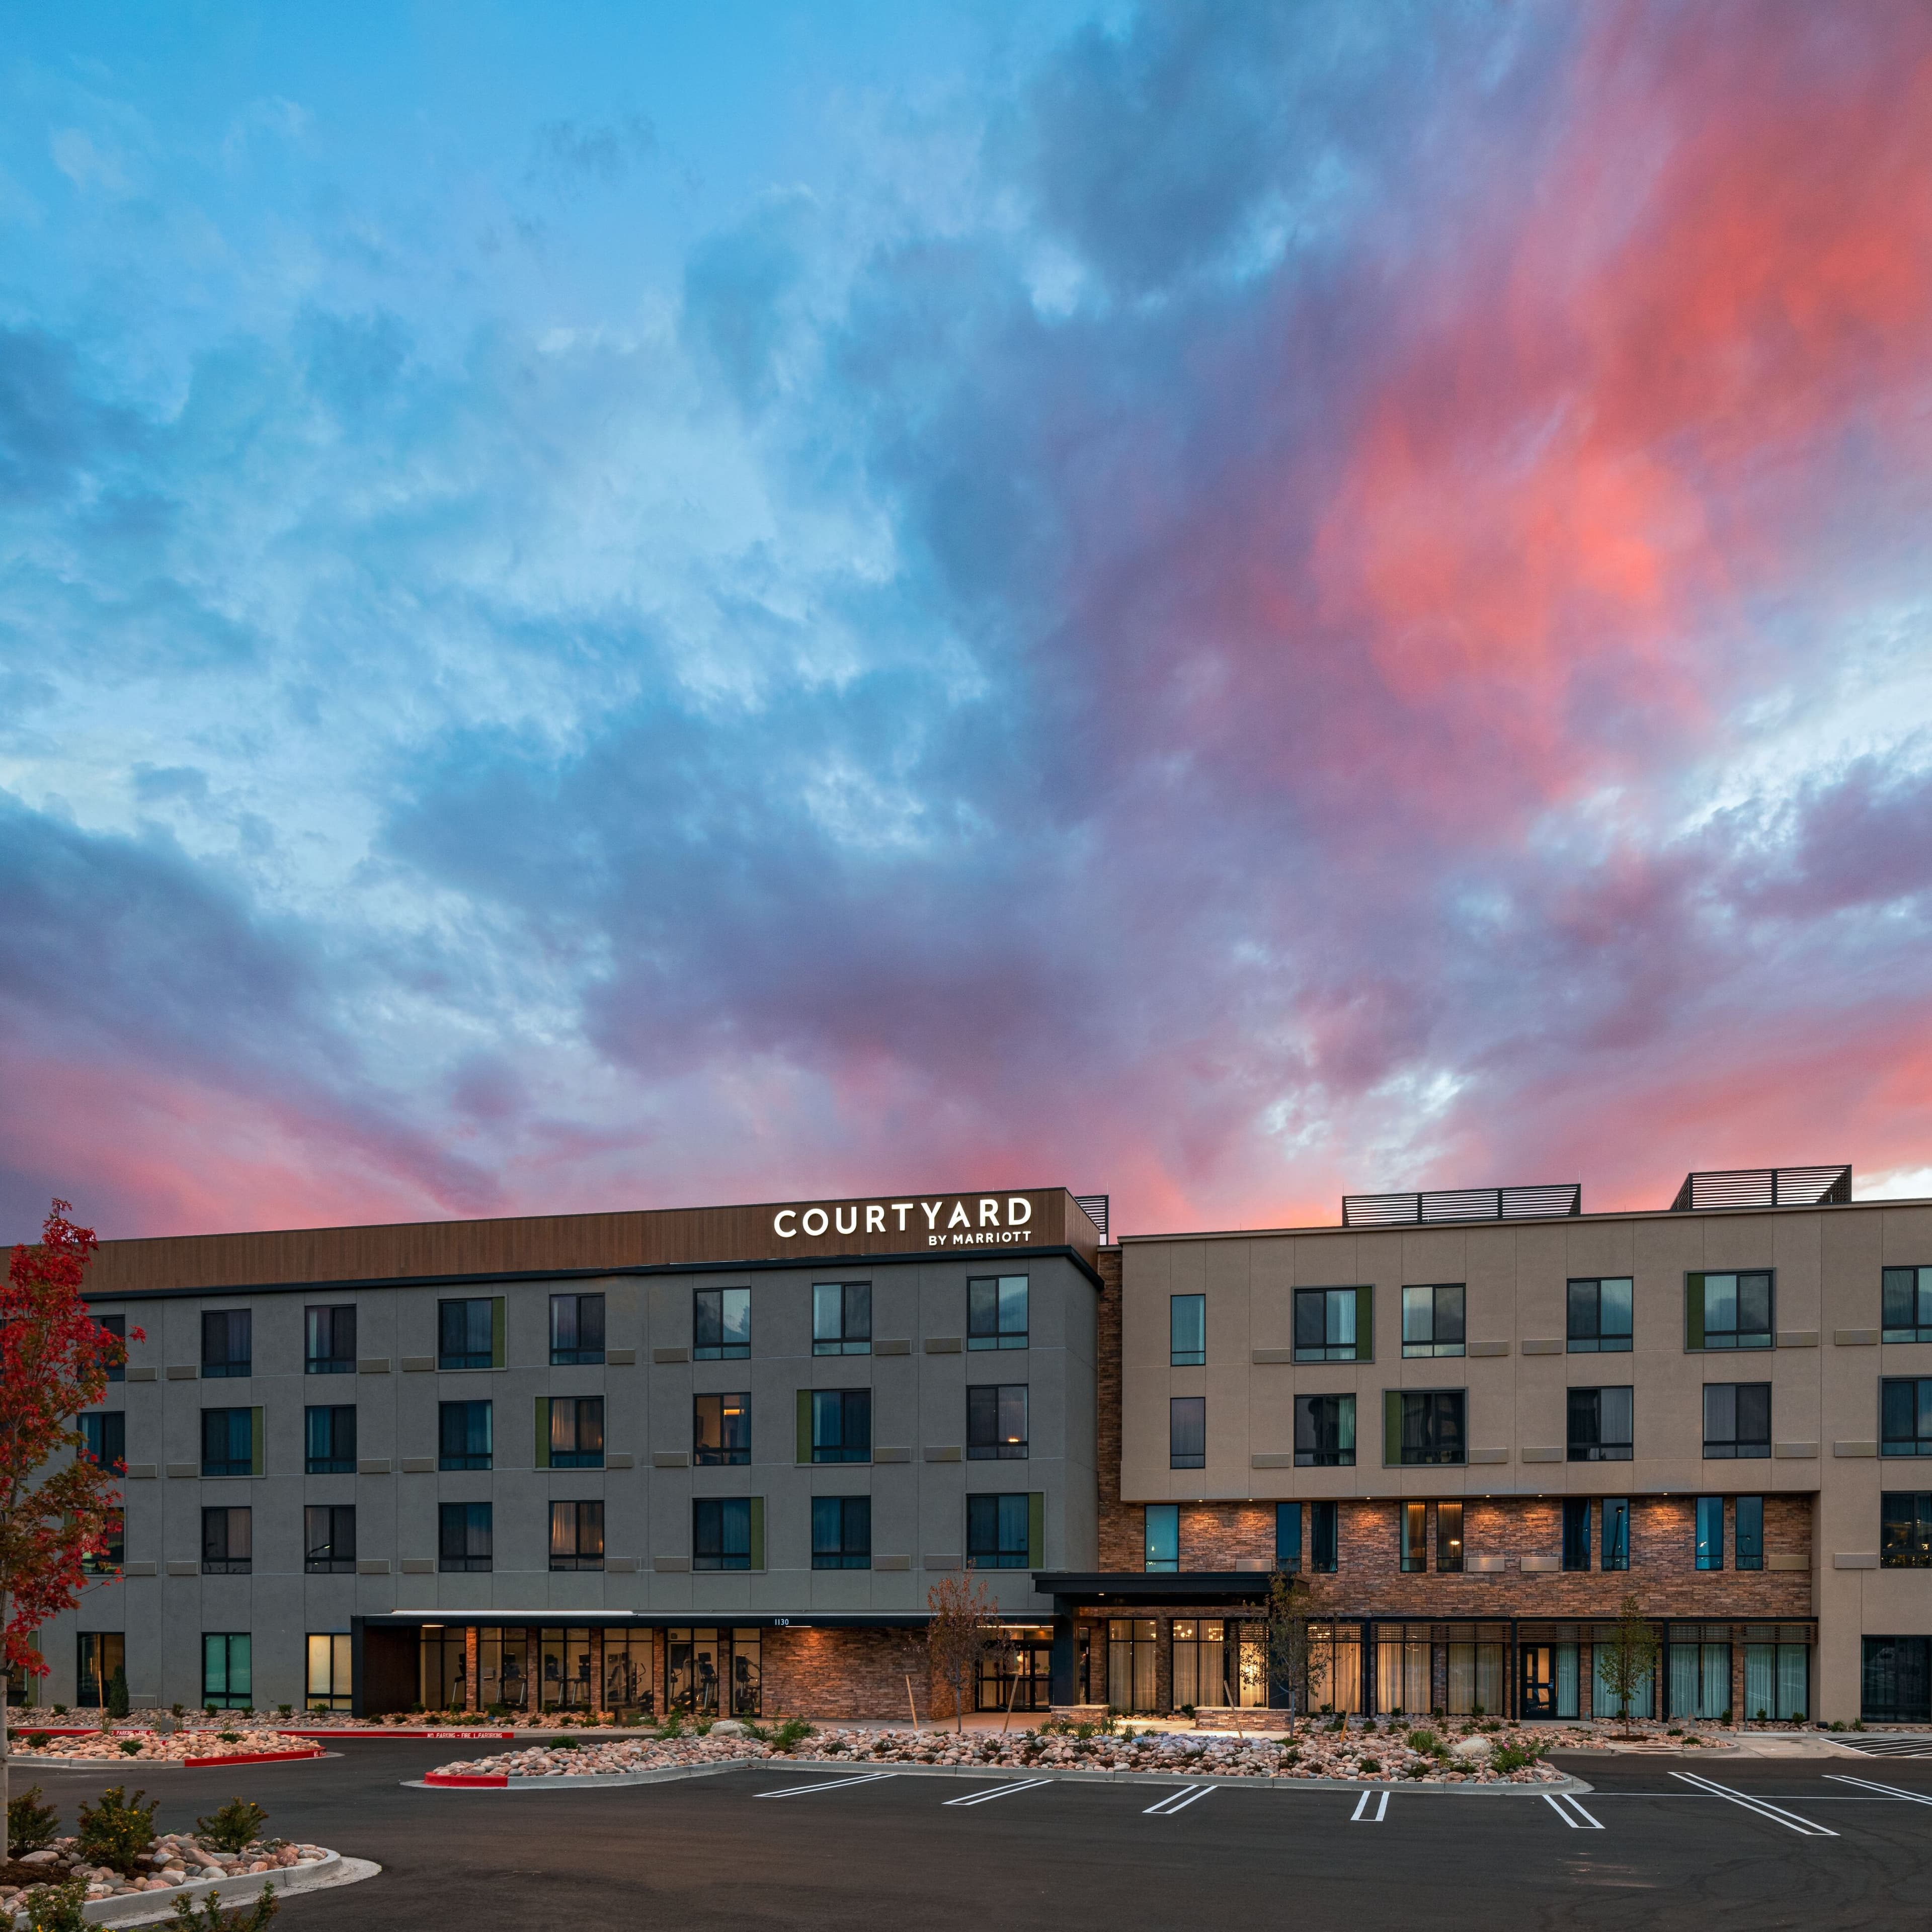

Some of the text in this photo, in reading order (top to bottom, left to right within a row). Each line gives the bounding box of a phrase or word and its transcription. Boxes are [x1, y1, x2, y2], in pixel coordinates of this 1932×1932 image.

[774, 1197, 1032, 1238] COURTYARD
[929, 1231, 1031, 1246] BY MARRIOTT
